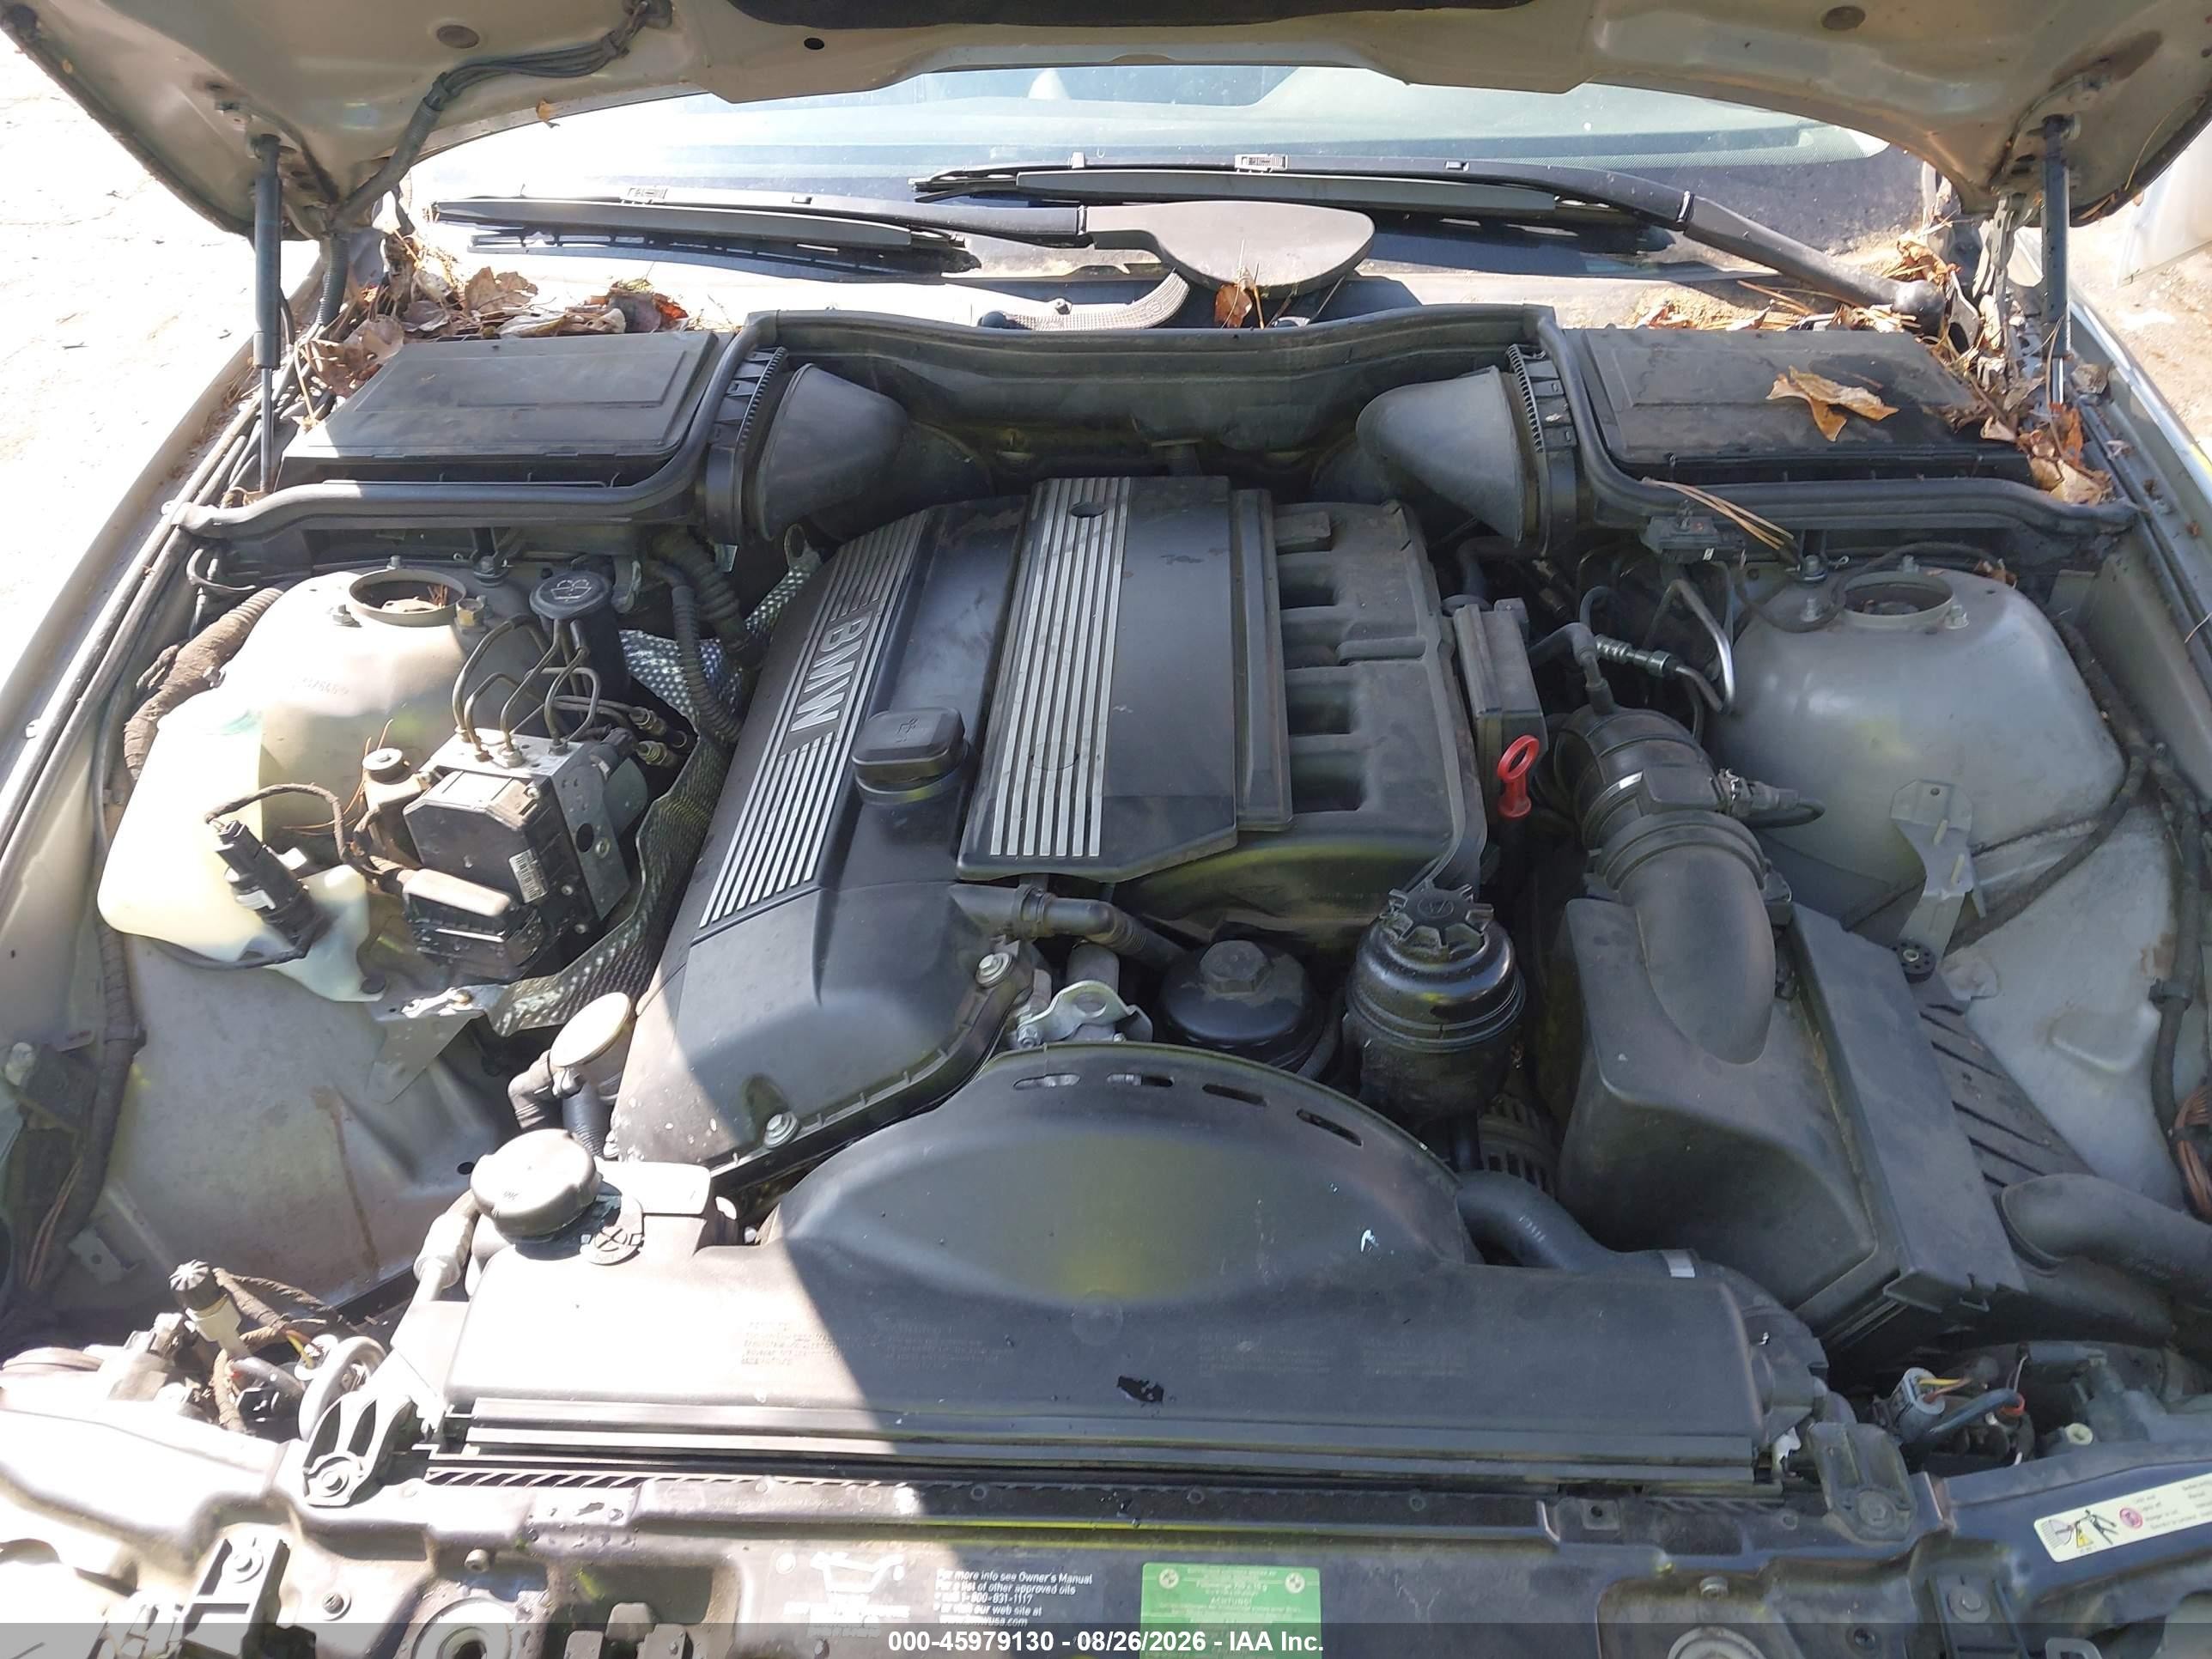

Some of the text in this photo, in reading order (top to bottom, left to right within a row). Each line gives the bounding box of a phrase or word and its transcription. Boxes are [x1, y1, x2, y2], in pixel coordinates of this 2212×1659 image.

[790, 615, 872, 732] BMW
[955, 1571, 979, 1581] more
[981, 1571, 999, 1582] info
[1000, 1572, 1017, 1583] see
[1018, 1571, 1057, 1583] Owner's
[1059, 1573, 1092, 1584] Manual
[961, 1580, 976, 1592] list
[977, 1582, 989, 1592] of
[988, 1582, 1013, 1593] other
[1014, 1584, 1057, 1595] approved
[1059, 1584, 1075, 1595] oils
[973, 1604, 992, 1615] our
[992, 1605, 1012, 1616] web
[1013, 1605, 1030, 1616] site
[1032, 1606, 1042, 1617] at
